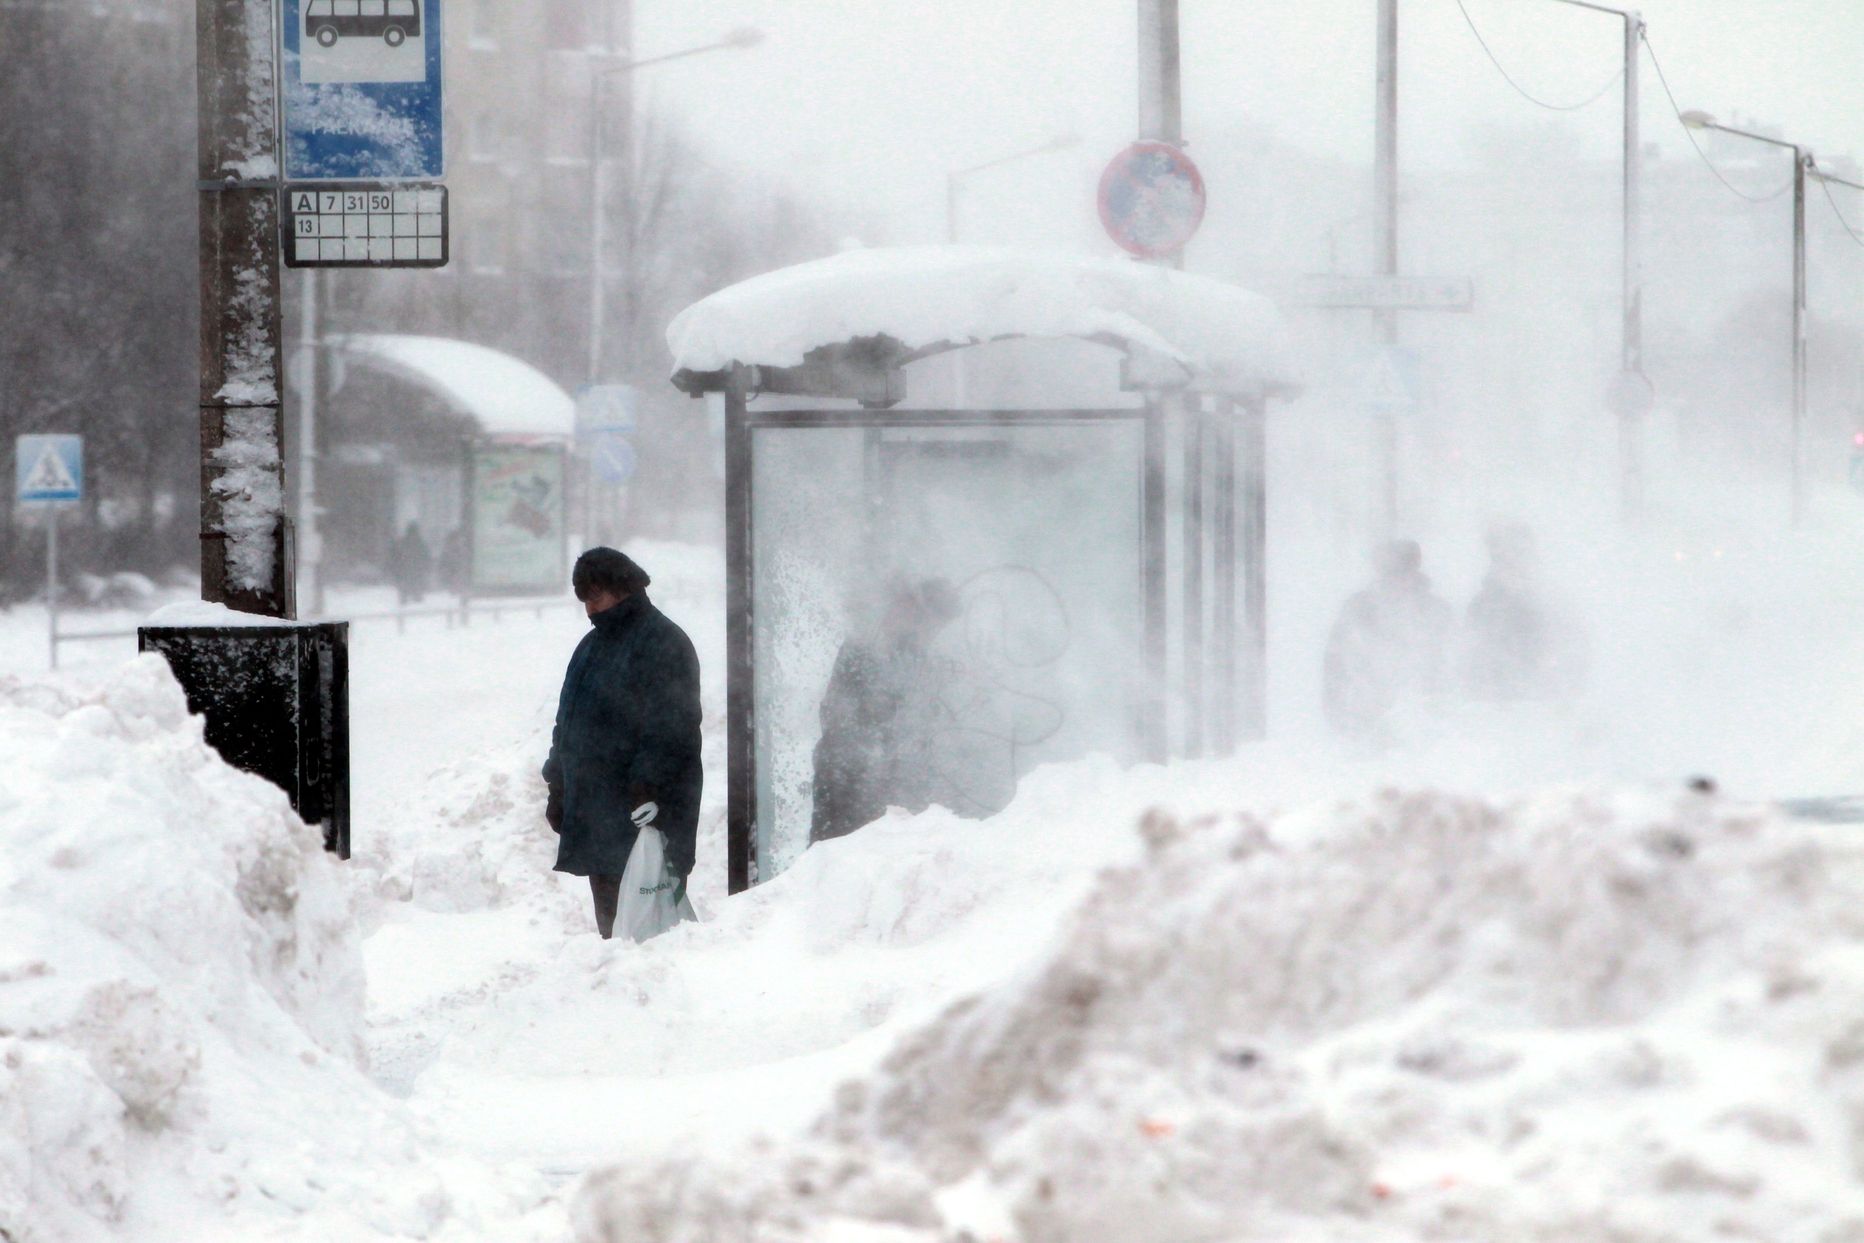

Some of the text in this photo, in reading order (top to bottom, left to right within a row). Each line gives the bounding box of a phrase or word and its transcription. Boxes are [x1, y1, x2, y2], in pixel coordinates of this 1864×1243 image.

[297, 194, 390, 211] A 7 31 50
[298, 220, 313, 233] 13
